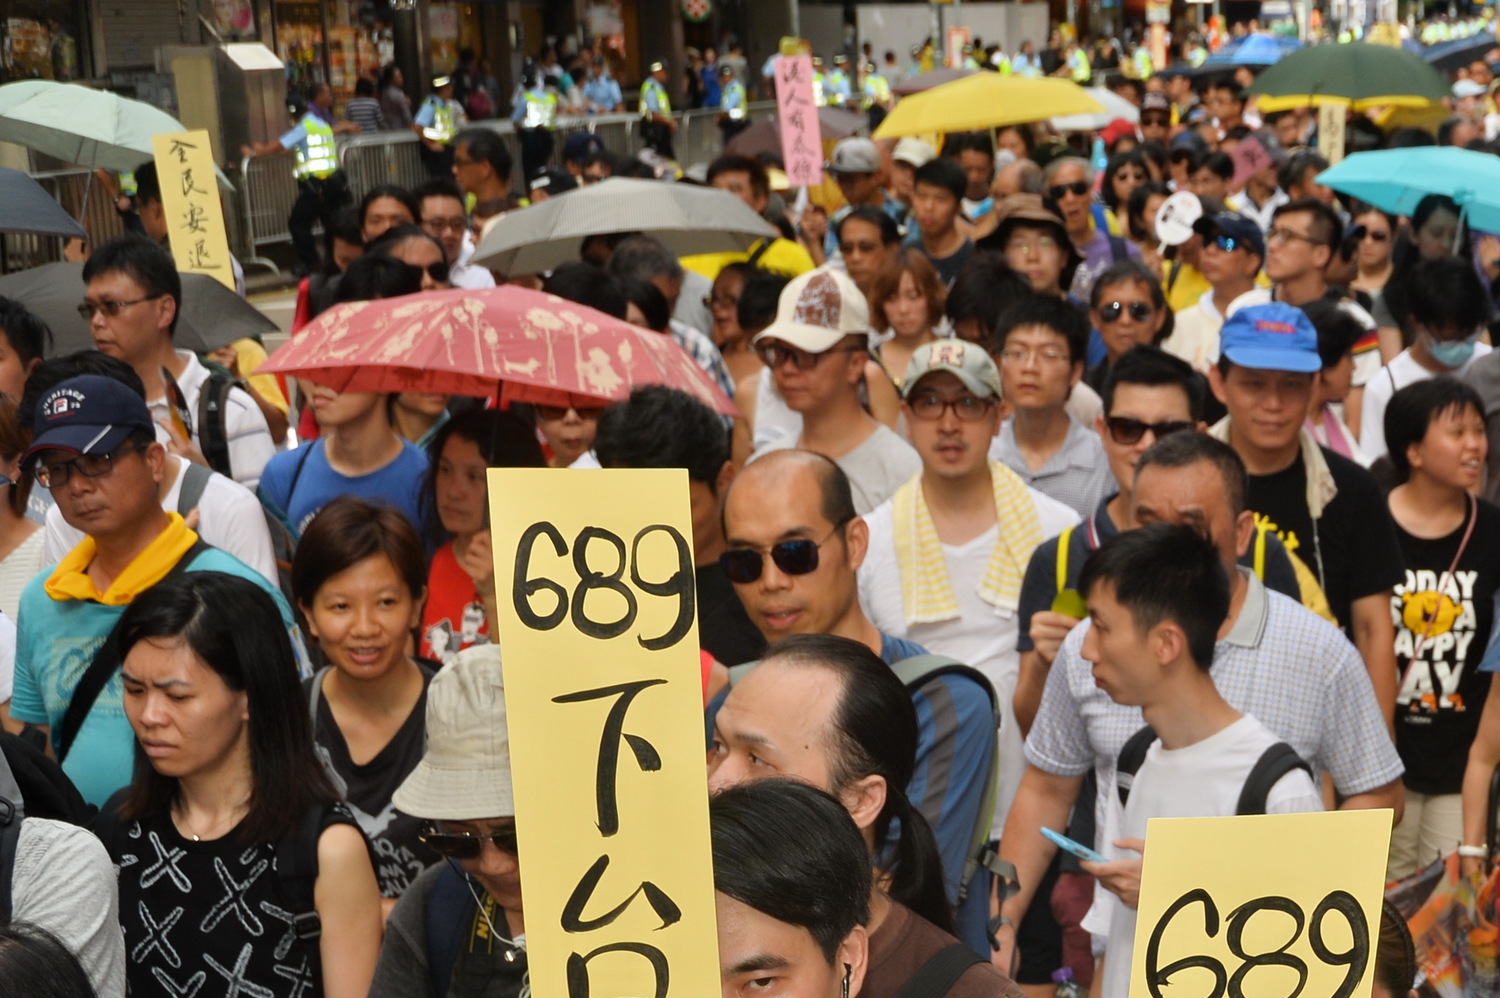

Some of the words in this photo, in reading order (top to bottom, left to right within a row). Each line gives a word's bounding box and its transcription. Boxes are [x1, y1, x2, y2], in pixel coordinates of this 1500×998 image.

[513, 521, 696, 651] 689
[1394, 628, 1475, 662] APPY
[1396, 660, 1465, 708] AY
